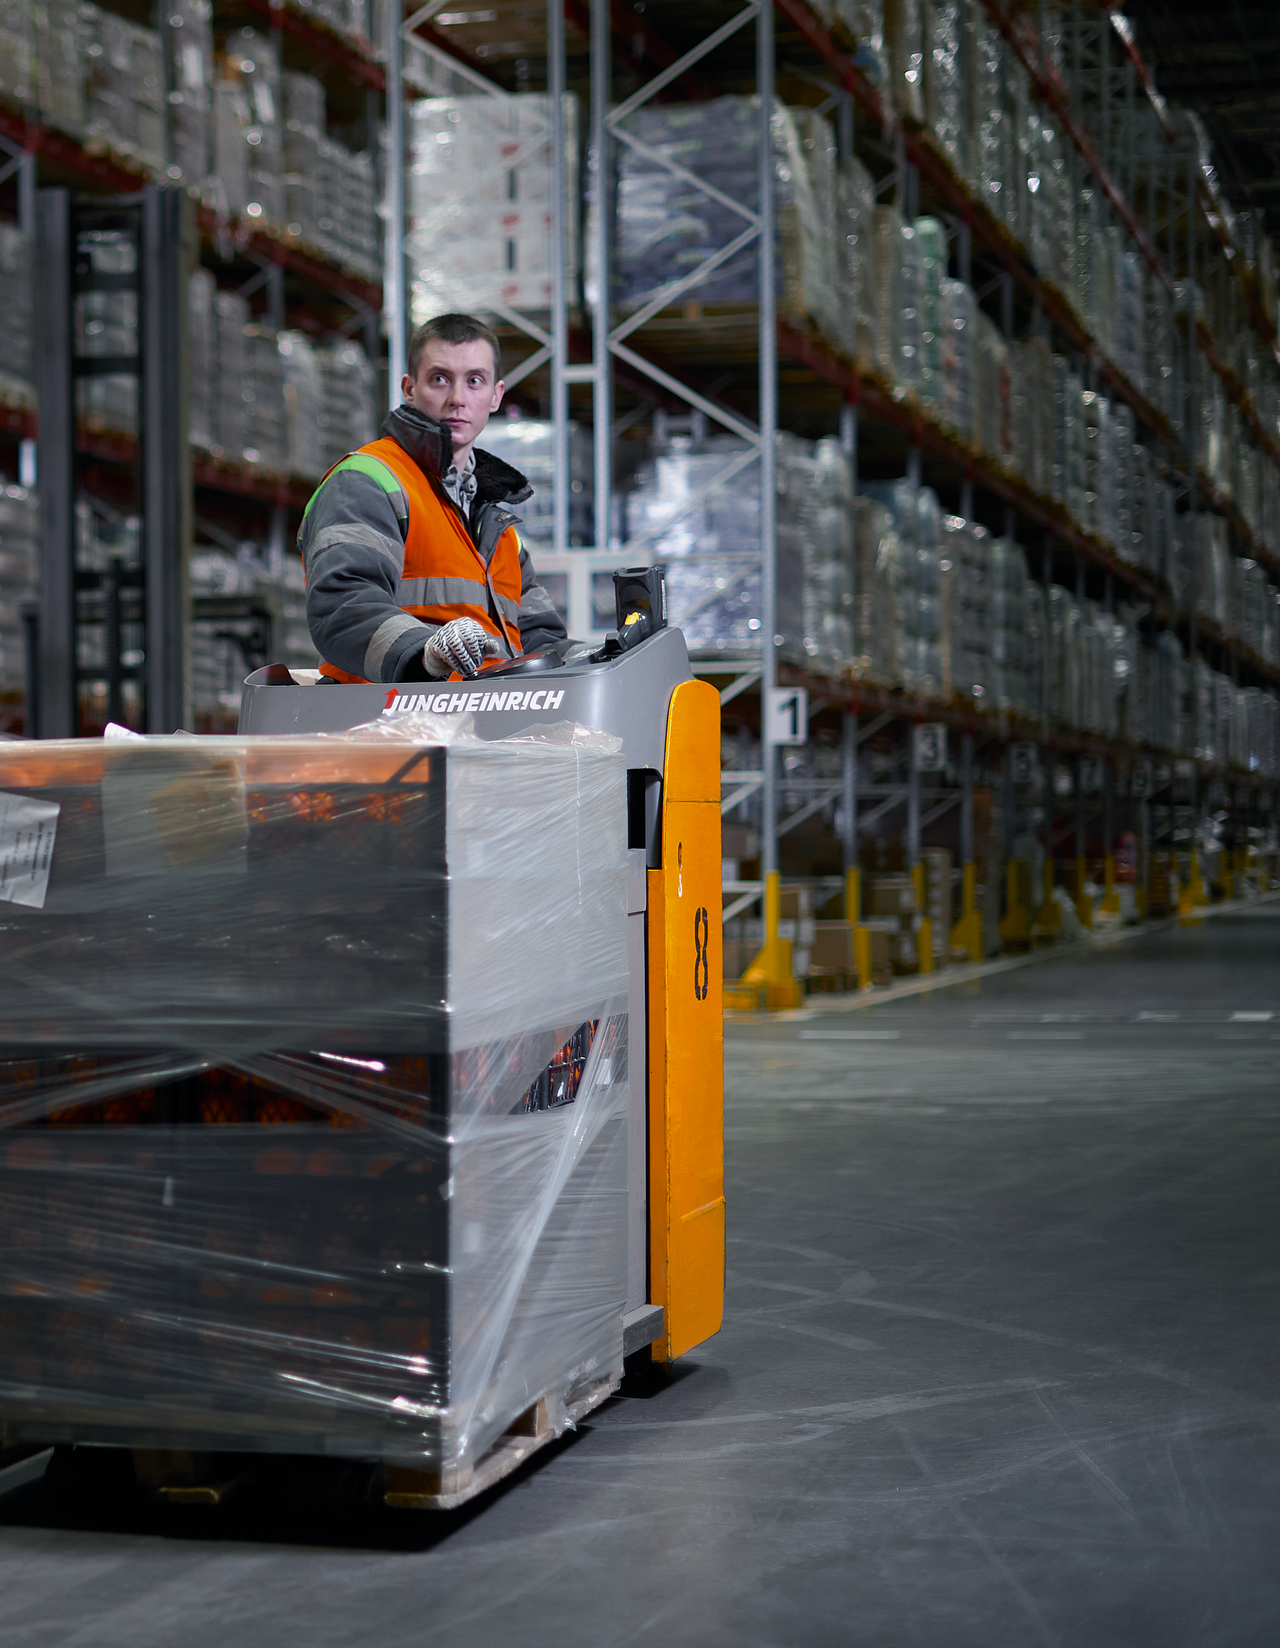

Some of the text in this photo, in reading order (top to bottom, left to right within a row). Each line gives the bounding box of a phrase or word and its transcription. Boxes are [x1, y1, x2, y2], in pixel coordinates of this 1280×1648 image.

[382, 688, 565, 716] JUNGHEINRICH
[779, 697, 799, 735] 1
[922, 731, 939, 763] 3
[695, 907, 708, 1000] 8
